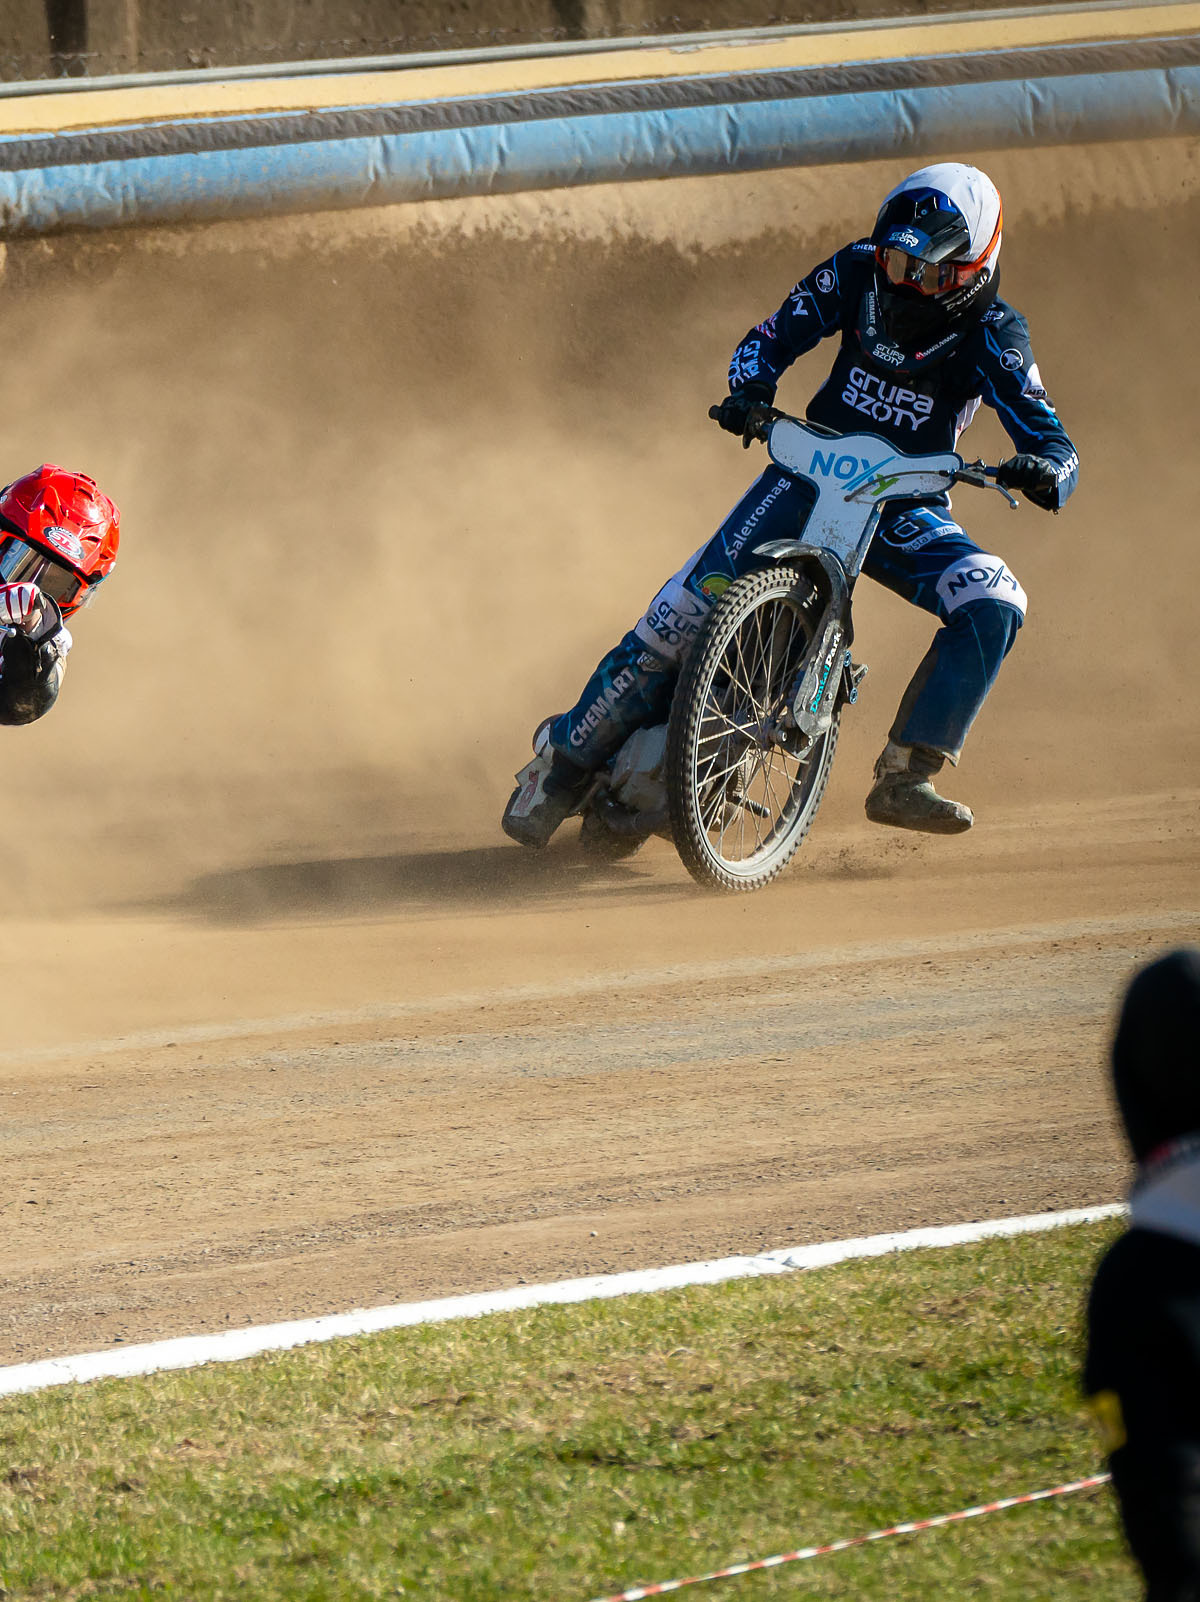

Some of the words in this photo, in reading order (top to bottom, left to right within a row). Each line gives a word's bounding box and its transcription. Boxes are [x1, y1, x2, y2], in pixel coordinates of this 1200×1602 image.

[852, 243, 877, 252] CHEM
[725, 477, 792, 560] Saletromag
[569, 666, 635, 747] CHEMART
[810, 632, 842, 713] DentalPark
